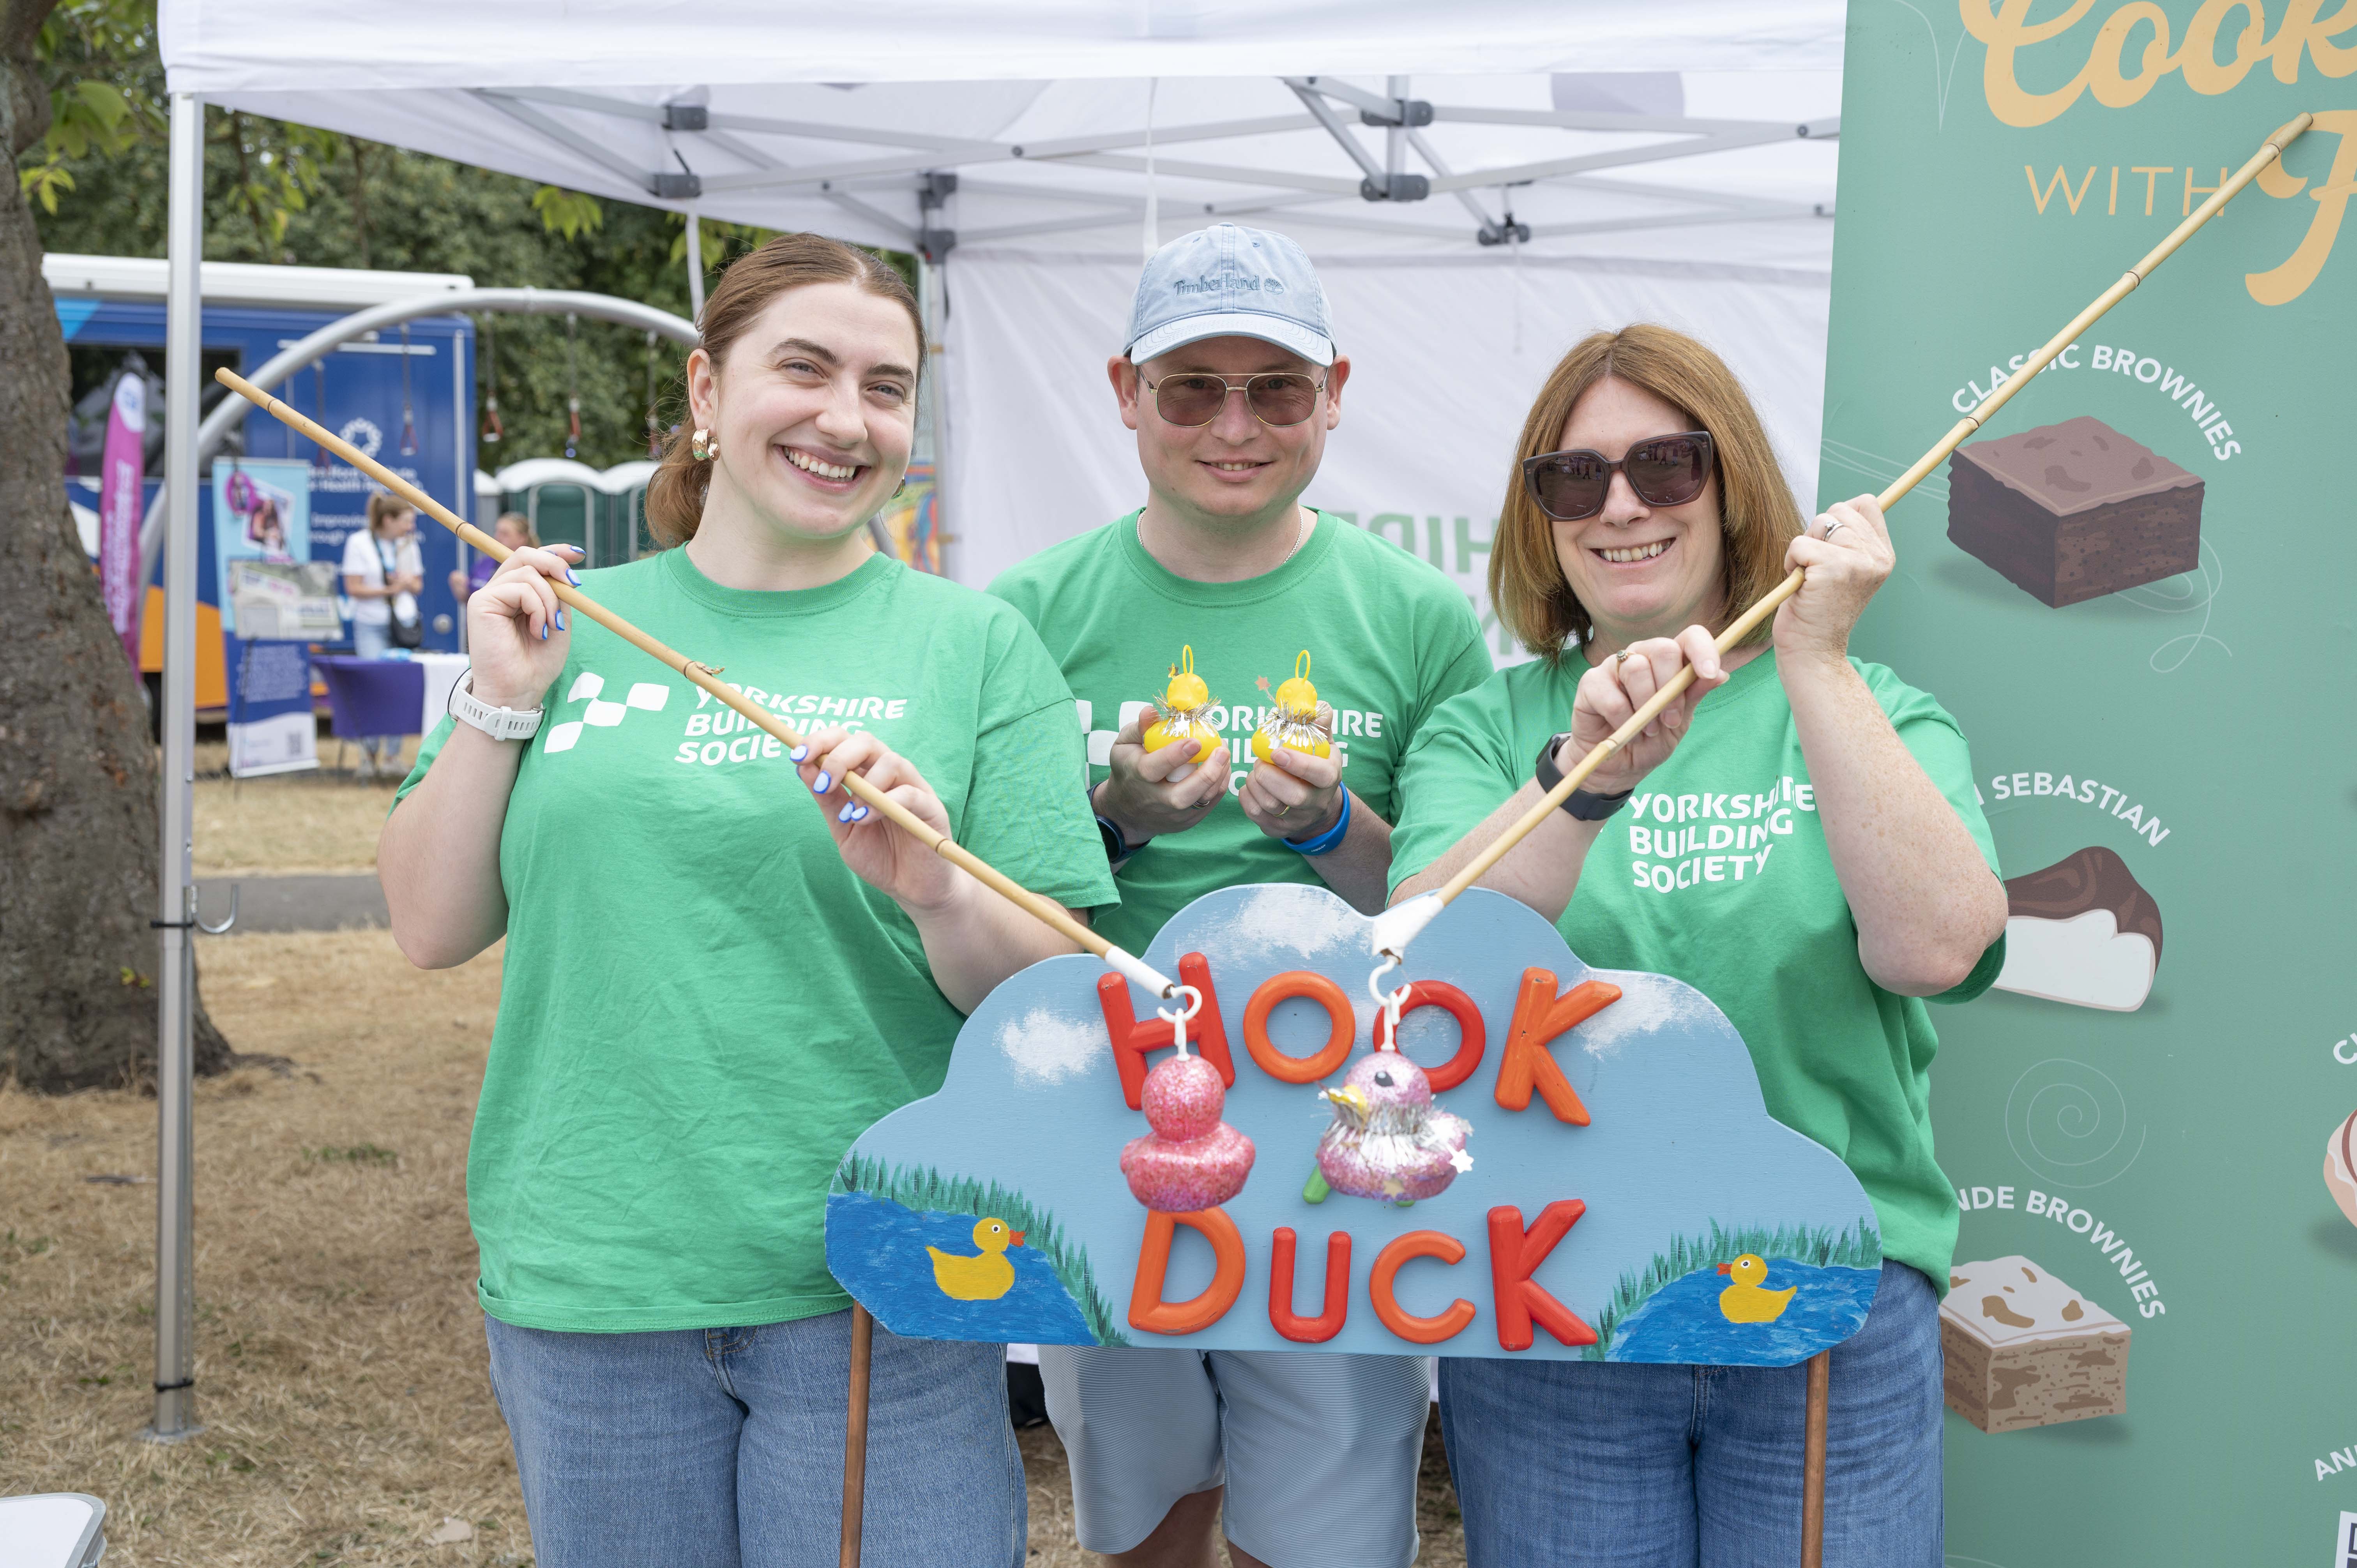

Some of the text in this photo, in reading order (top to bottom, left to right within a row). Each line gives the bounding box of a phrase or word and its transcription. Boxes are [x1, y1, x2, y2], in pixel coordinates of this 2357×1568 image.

[2025, 165, 2228, 217] WITH
[1173, 273, 1261, 296] Timberland
[2092, 344, 2241, 461] BROWNIES
[674, 733, 781, 766] SOCIE
[1628, 776, 1816, 823] YORKSHIRE
[1992, 772, 2171, 847] SEBASTIAN
[1629, 808, 1793, 858] BUILDING
[1632, 844, 1773, 893] SOCIETY
[1097, 952, 1622, 1127] HOOK
[1127, 1199, 1597, 1352] DUCK
[2025, 1190, 2166, 1318] BROWNIES
[2315, 1444, 2357, 1481] AN
